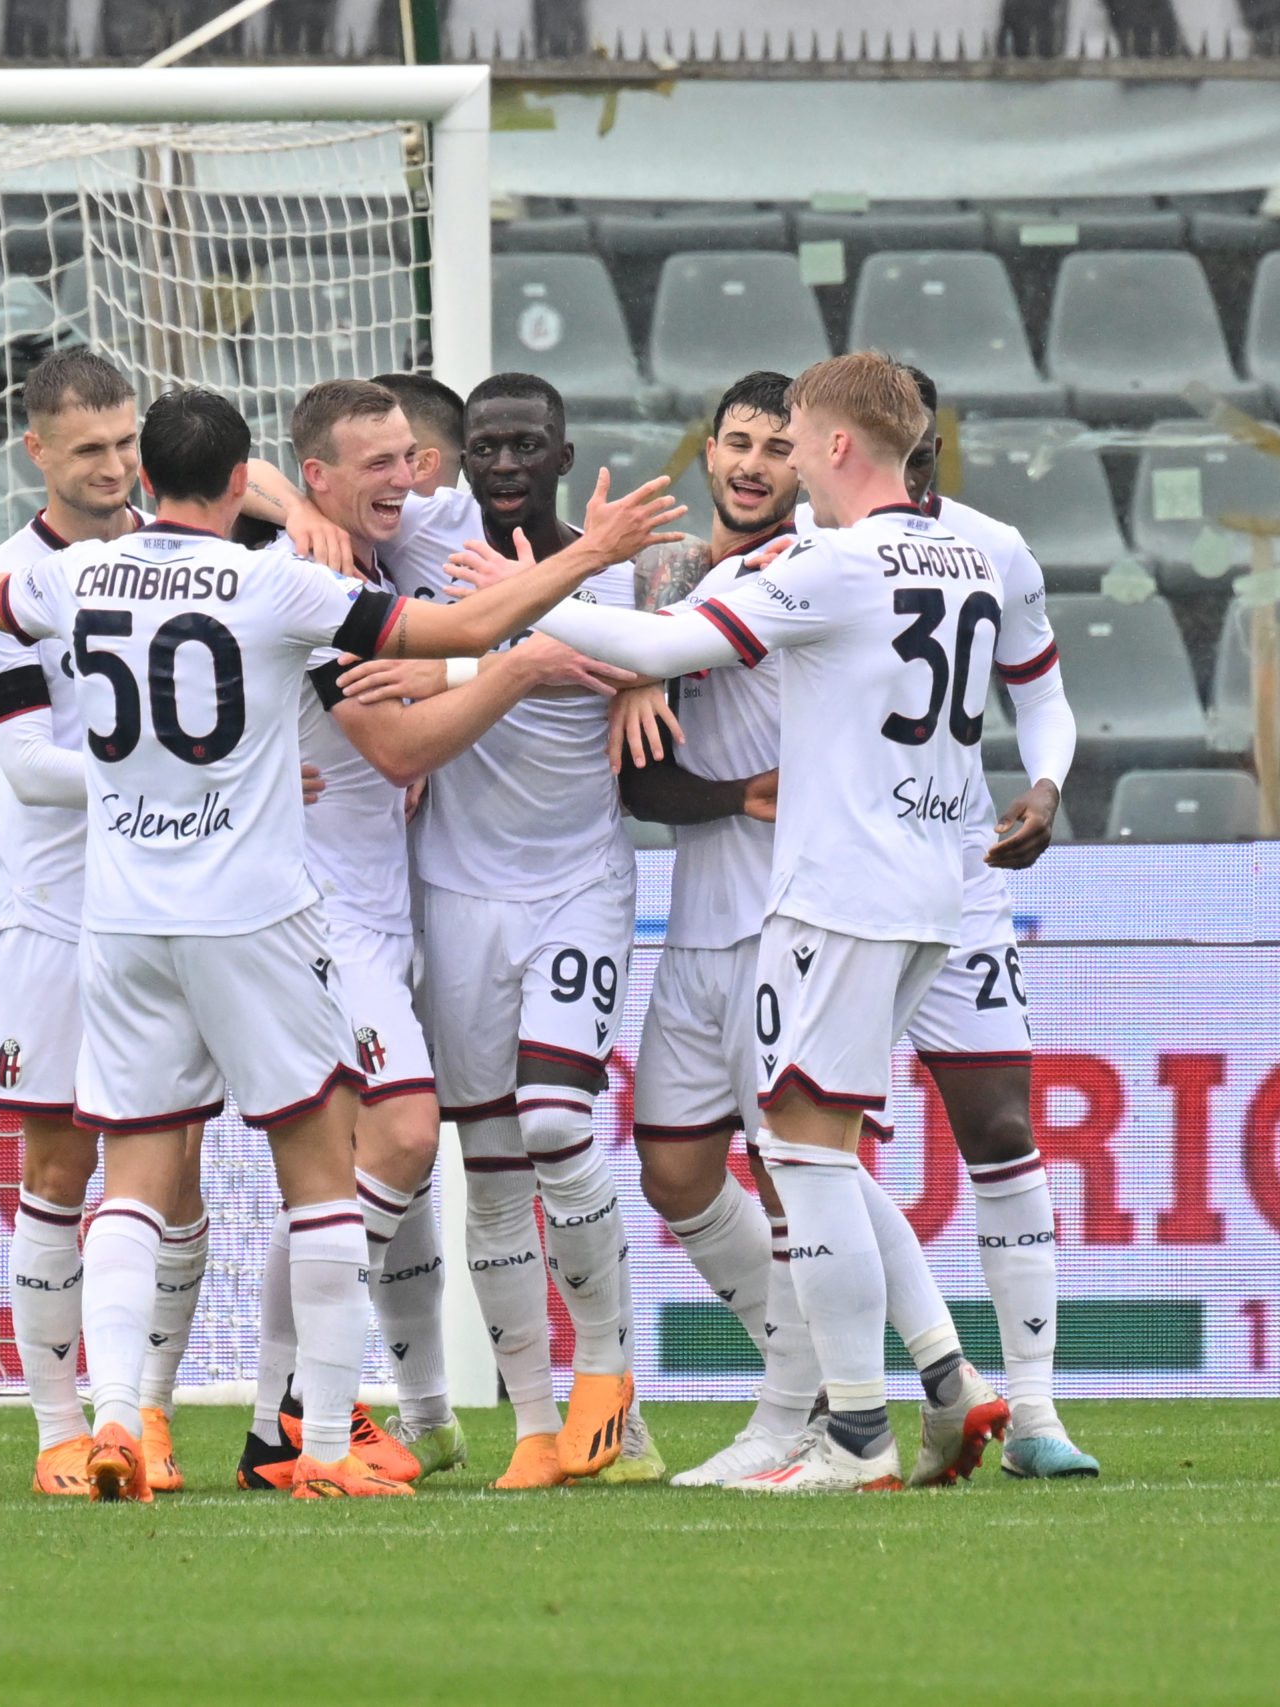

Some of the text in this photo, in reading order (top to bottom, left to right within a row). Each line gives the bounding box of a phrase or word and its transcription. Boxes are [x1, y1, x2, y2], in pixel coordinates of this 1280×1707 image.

[75, 563, 239, 602] CAMBIASO
[73, 608, 246, 767] 50
[881, 588, 1002, 747] 30
[550, 948, 618, 1015] 99
[965, 947, 1027, 1012] 26
